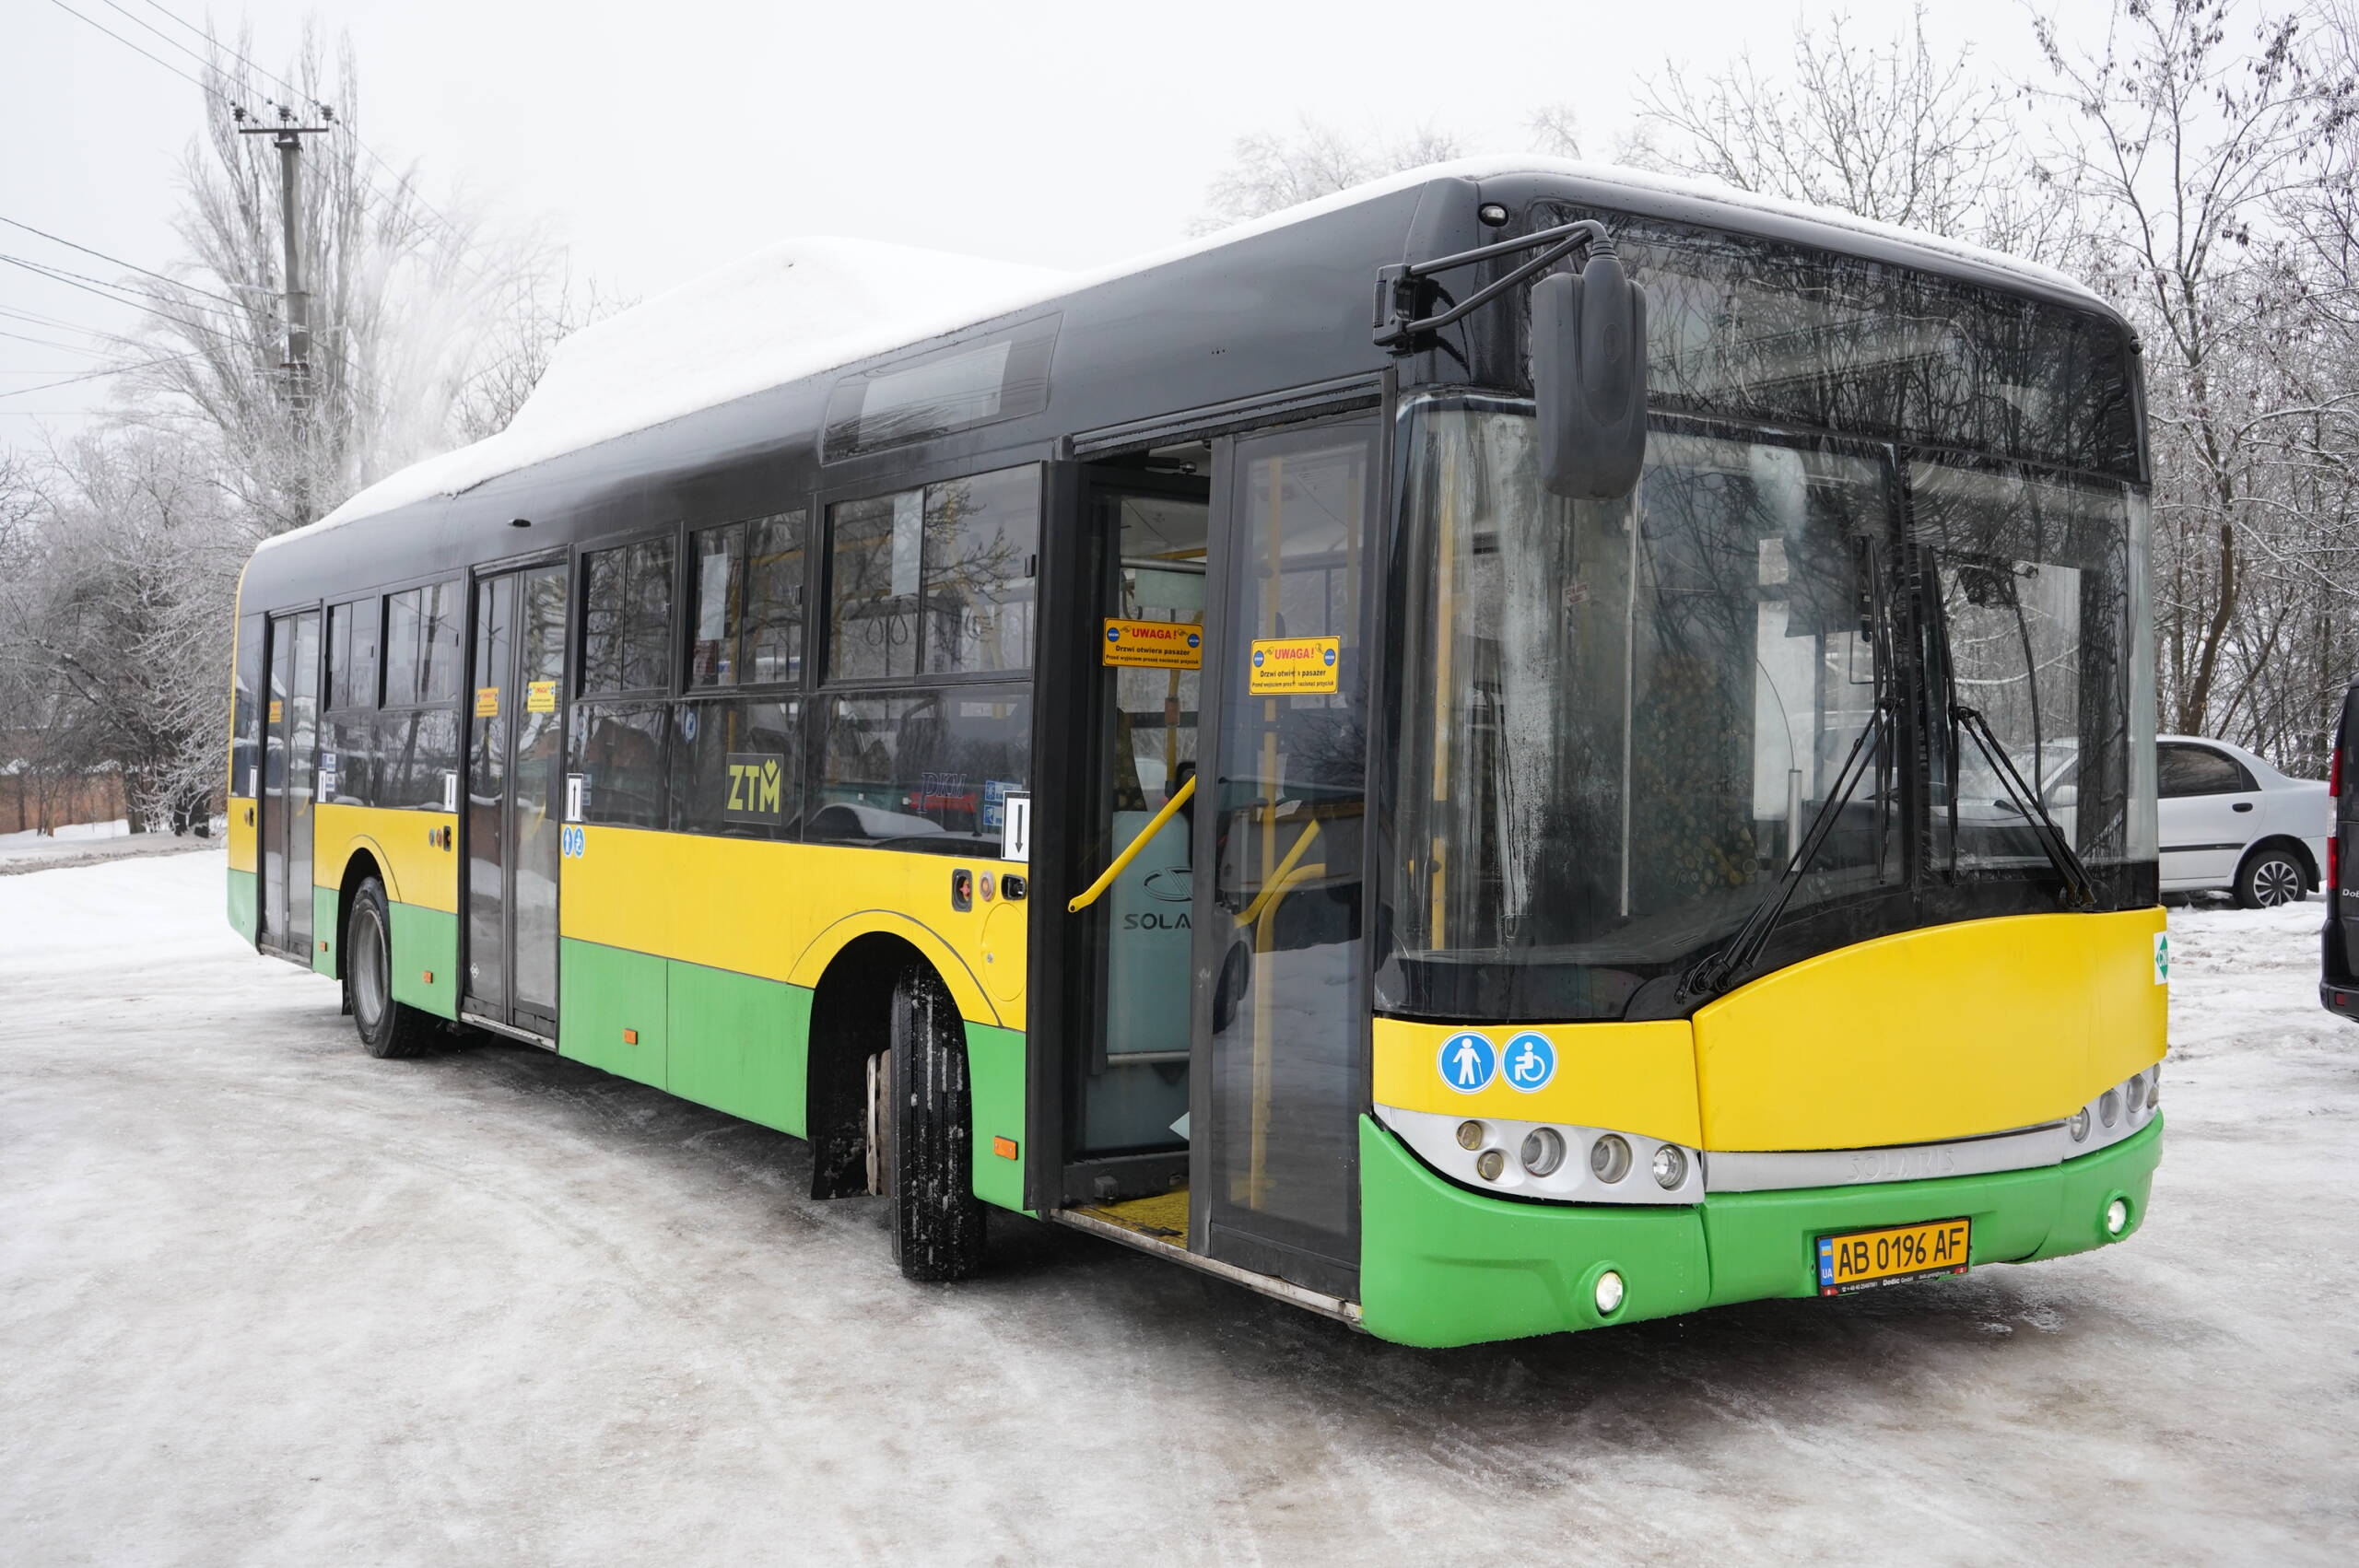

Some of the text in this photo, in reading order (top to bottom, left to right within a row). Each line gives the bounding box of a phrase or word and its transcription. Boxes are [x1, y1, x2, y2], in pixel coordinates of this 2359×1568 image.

[1136, 646, 1162, 654] otwiera
[727, 760, 781, 813] ZTM
[1847, 1149, 1954, 1181] SOLARIS
[1838, 1227, 1965, 1277] AB 0196 AF
[1822, 1269, 1833, 1279] UA
